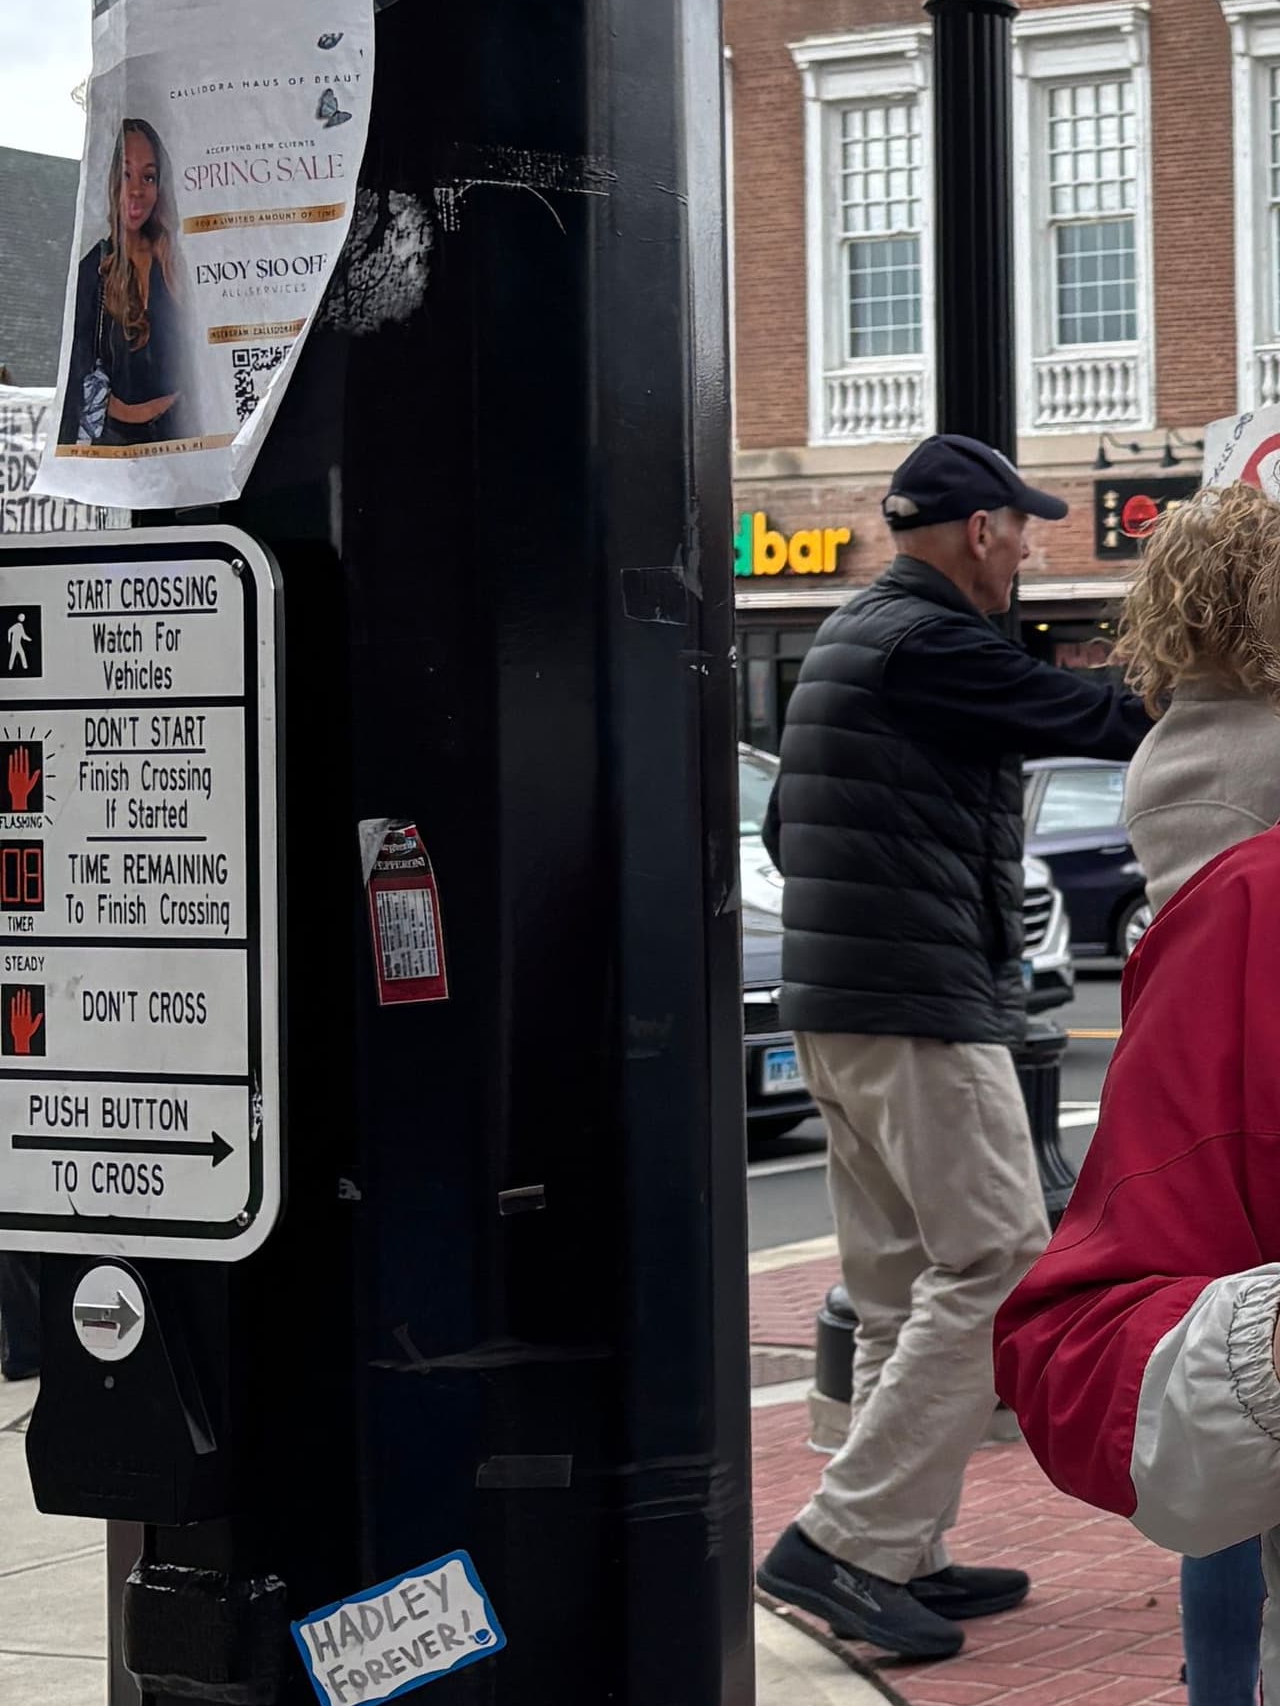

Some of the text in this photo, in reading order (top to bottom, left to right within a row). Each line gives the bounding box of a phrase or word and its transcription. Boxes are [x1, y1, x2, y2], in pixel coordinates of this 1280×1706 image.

[170, 81, 234, 100] CALLIDORA
[242, 78, 280, 89] HAUS
[288, 76, 305, 87] OF
[206, 139, 316, 156] ACCEPTING NEW CLIENTS
[183, 153, 345, 192] SPRING SALE
[220, 215, 255, 226] LIMITED
[258, 212, 297, 223] AMOUNT
[301, 211, 313, 219] OF
[196, 254, 328, 285] ENJOY $10 OFF
[245, 283, 307, 295] SERVICES
[67, 575, 218, 611] START CROSSING
[93, 621, 182, 654] Watch For
[103, 660, 173, 691] Vehicles
[85, 715, 206, 748] DON'T START
[79, 759, 212, 800] Finish Crossing
[0, 815, 43, 830] FLASHING
[106, 798, 188, 829] If Started
[68, 853, 229, 886] TIME REMAINING
[7, 916, 34, 933] TIMER
[66, 893, 231, 935] To Finish Crossing
[4, 956, 46, 972] STEADY
[82, 990, 208, 1025] DON'T CROSS
[29, 1094, 190, 1132] PUSH BUTTON
[51, 1159, 165, 1197] TO CROSS
[308, 1572, 449, 1663] HADLEY
